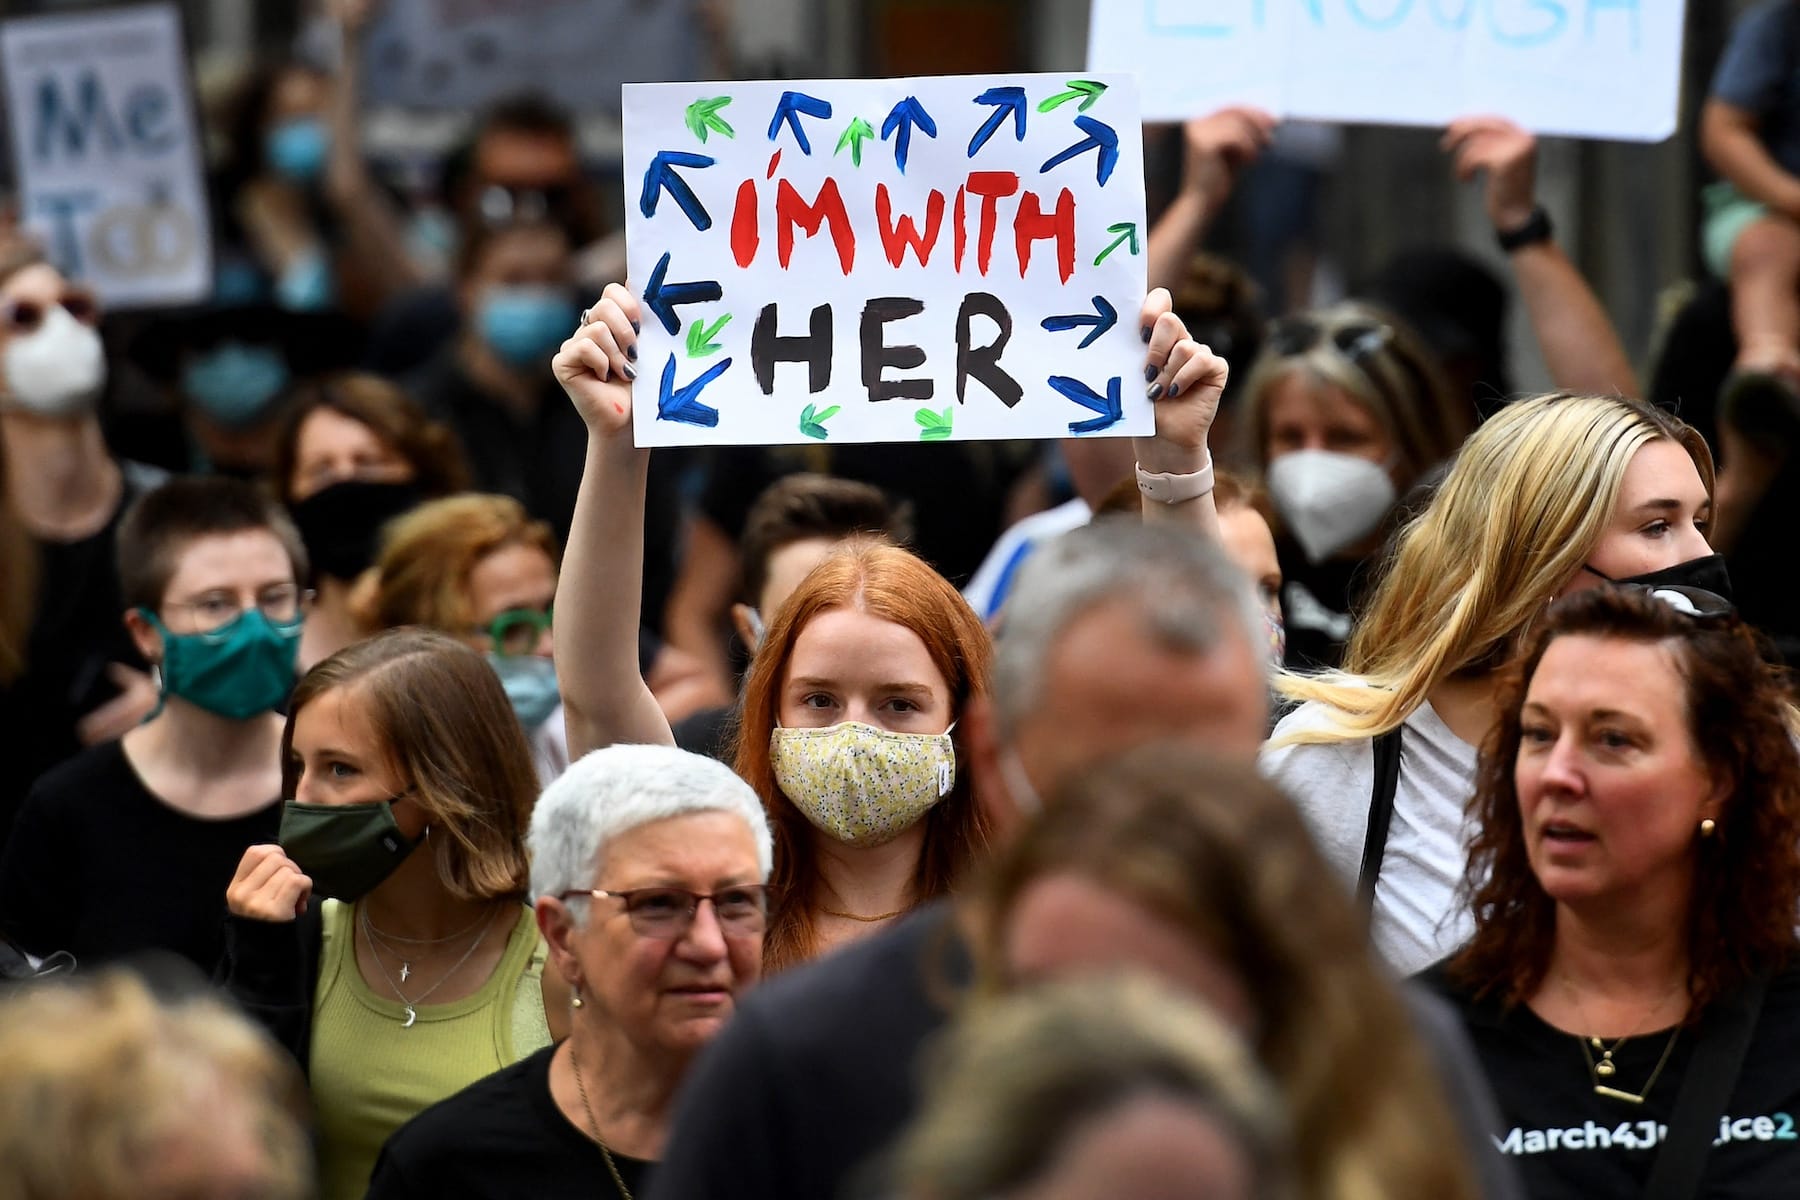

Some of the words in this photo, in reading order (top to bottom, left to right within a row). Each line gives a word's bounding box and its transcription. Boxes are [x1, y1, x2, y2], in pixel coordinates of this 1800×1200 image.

[34, 72, 174, 162] Me
[731, 149, 856, 276] I'M
[876, 172, 1076, 285] WITH
[751, 291, 1024, 408] HER
